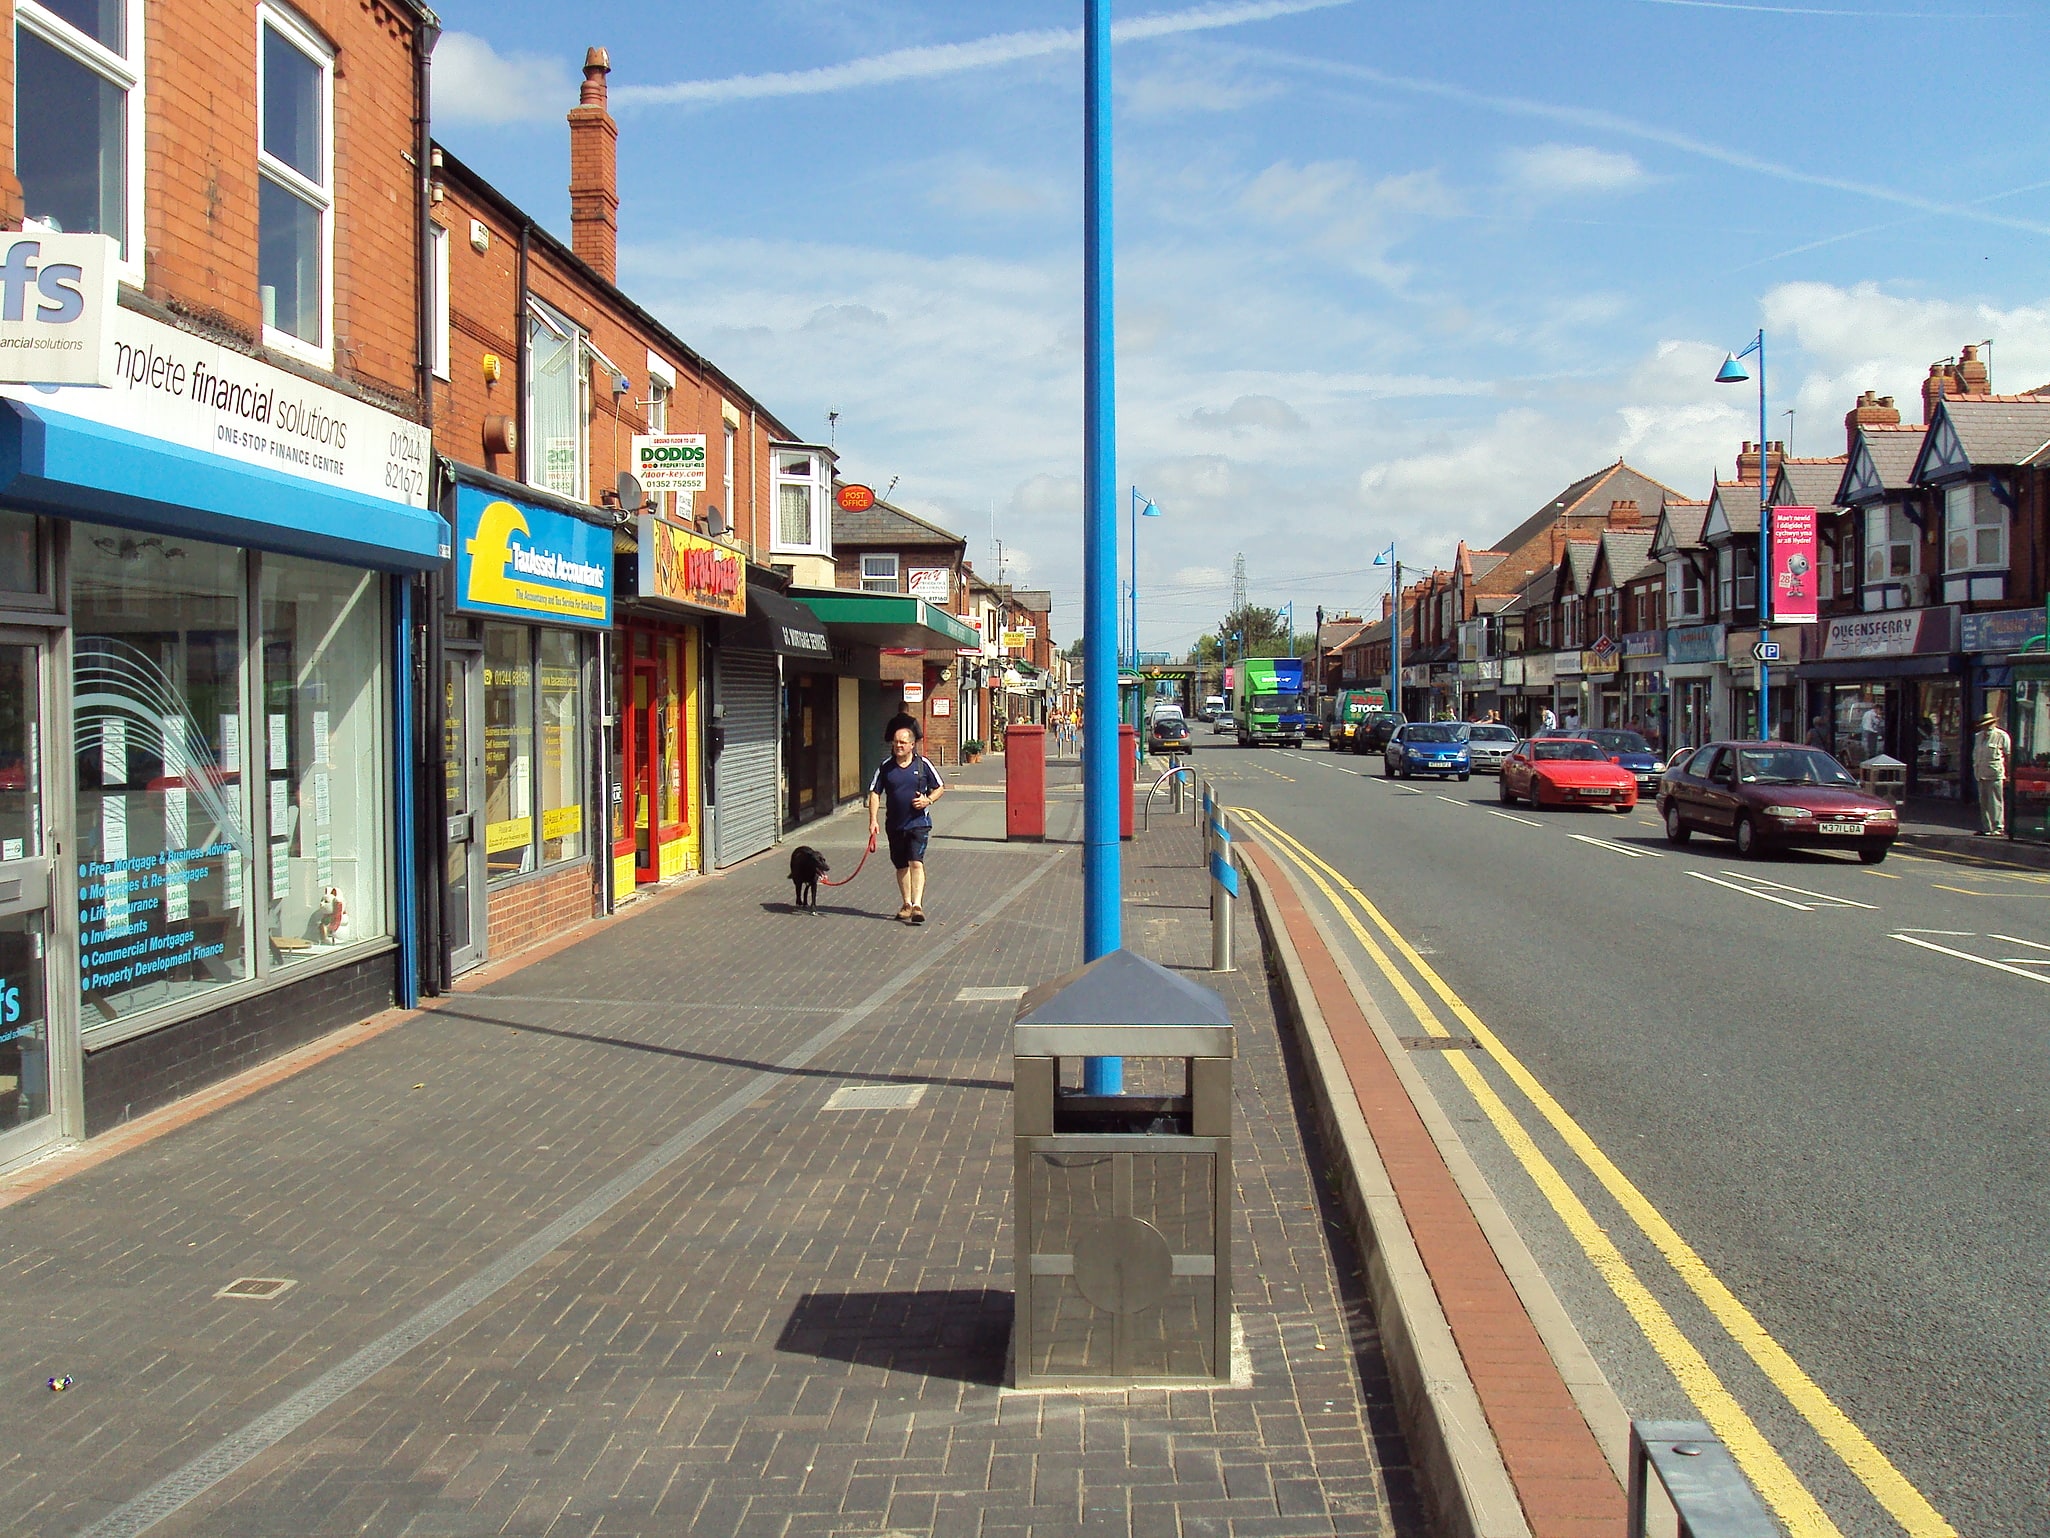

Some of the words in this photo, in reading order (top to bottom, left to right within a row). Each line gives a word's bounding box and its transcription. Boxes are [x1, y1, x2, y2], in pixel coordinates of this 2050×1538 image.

[34, 338, 83, 350] solutions
[192, 361, 274, 424] financial
[276, 399, 348, 449] solutions
[218, 424, 267, 453] ONE-STOP
[270, 441, 310, 465] FINANCE
[313, 454, 344, 476] CENTRE
[390, 431, 421, 466] 01244
[641, 447, 705, 461] DODDS
[385, 461, 424, 496] 821672
[646, 480, 671, 488] 01352
[841, 499, 868, 507] OFFICE
[512, 541, 557, 580] TaxAssist
[556, 553, 604, 589] Accountants
[1780, 574, 1791, 583] 28
[1832, 619, 1912, 639] QUEENSFERRY
[1767, 646, 1777, 657] P
[1350, 695, 1385, 704] TAKE
[1349, 704, 1385, 713] STOCK
[1821, 824, 1843, 832] M371
[89, 862, 111, 878] Free
[113, 854, 157, 873] Mortgage
[159, 851, 166, 865] &
[167, 847, 205, 862] Business
[205, 842, 232, 857] Advice
[142, 875, 149, 889] &
[91, 938, 148, 967] Commercial
[149, 930, 195, 952] Mortgages
[92, 967, 133, 990] Property
[135, 951, 192, 977] Development
[193, 942, 225, 961] Finance
